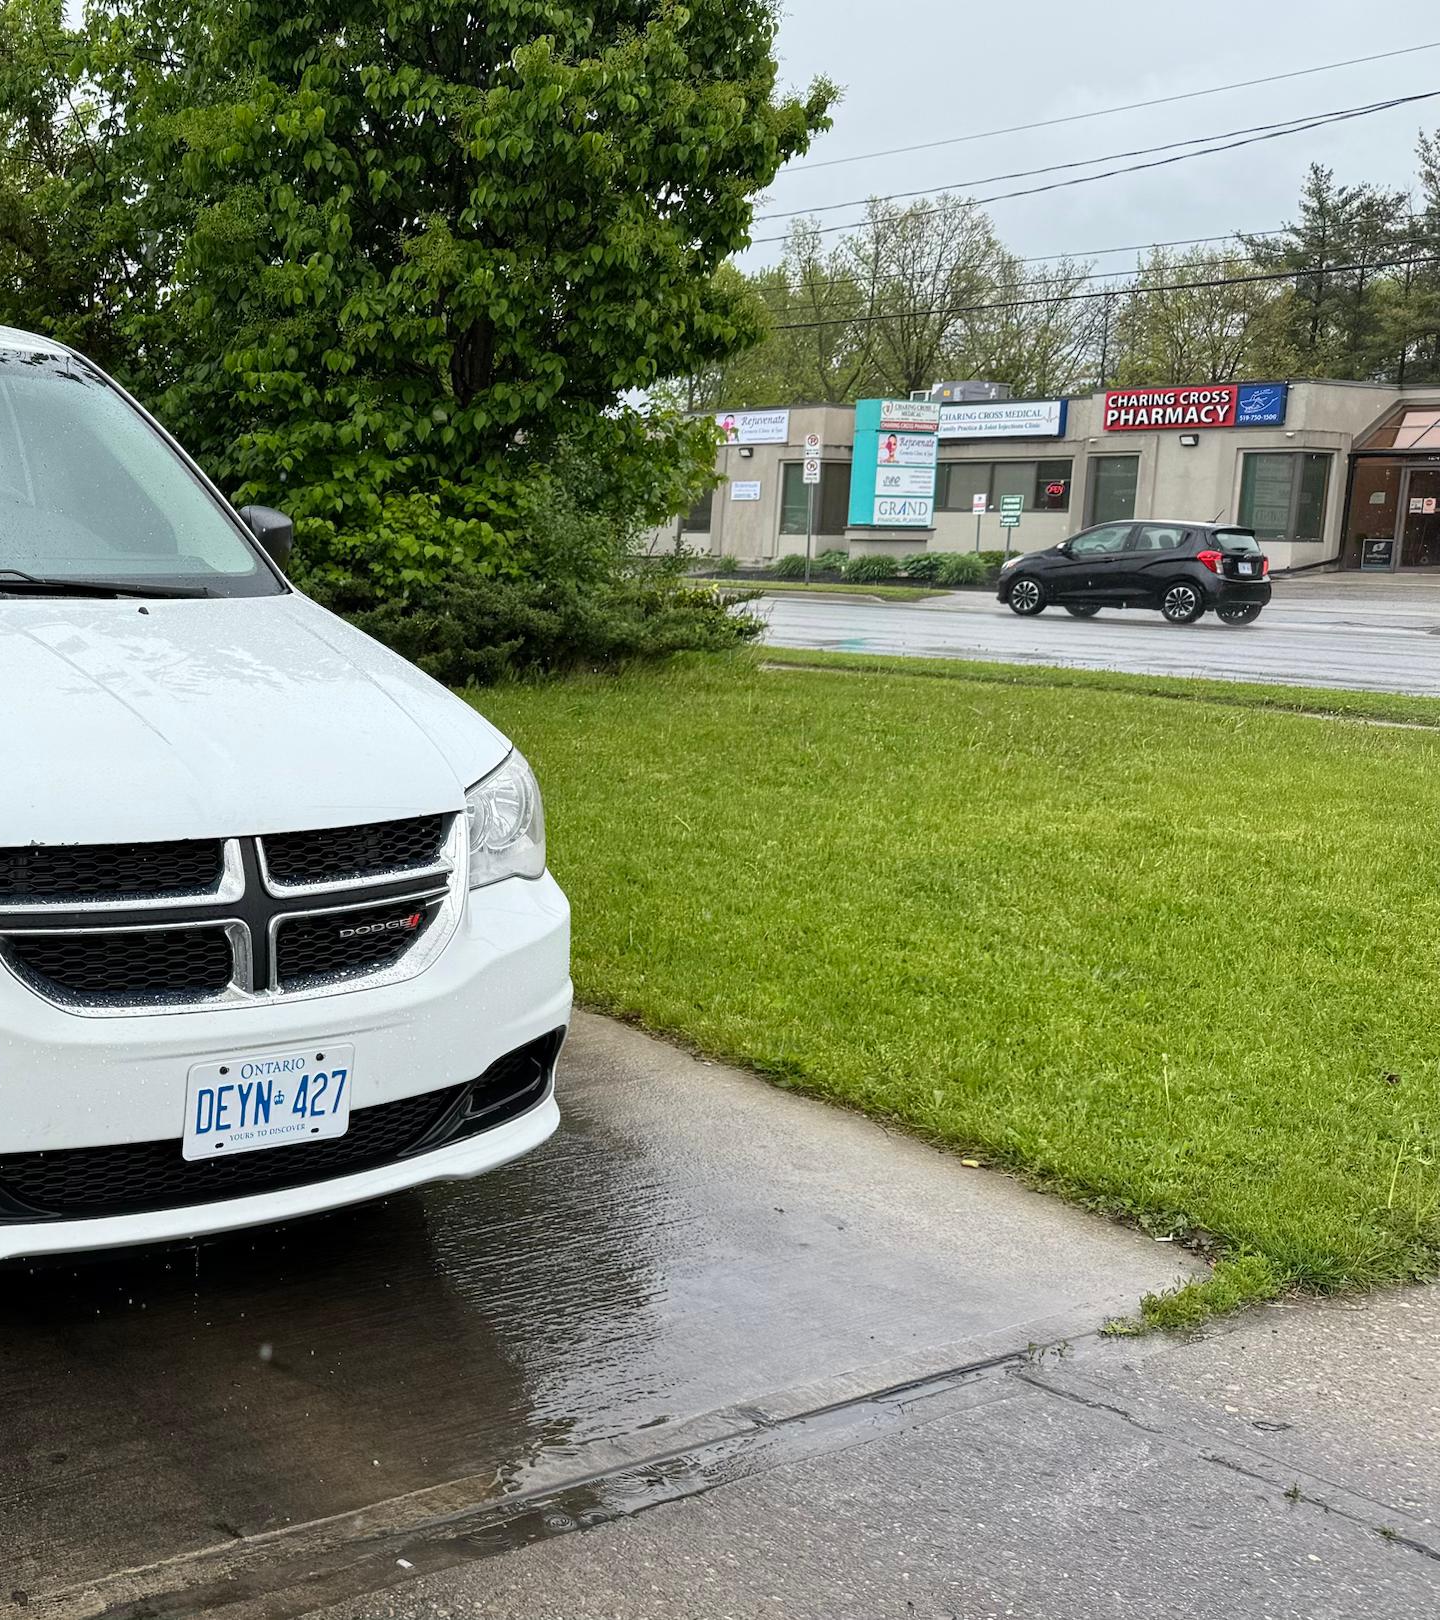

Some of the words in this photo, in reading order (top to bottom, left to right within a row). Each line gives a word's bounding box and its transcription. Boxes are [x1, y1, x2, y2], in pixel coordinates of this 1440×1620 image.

[1108, 392, 1176, 408] CHARING
[1179, 390, 1230, 404] CROSS
[741, 415, 786, 429] Rejuvenate
[940, 411, 977, 421] CHARING
[978, 410, 1004, 420] CROSS
[1005, 408, 1042, 419] MEDICAL
[1106, 404, 1230, 426] PHARMACY
[900, 436, 935, 450] Rejuvenate
[878, 500, 928, 516] GRAND
[340, 918, 410, 938] DODGE
[196, 1079, 273, 1135] DEYN
[292, 1069, 348, 1118] 427
[229, 1132, 255, 1142] YOURS
[257, 1129, 267, 1137] TO
[269, 1123, 306, 1136] DISCOVER
